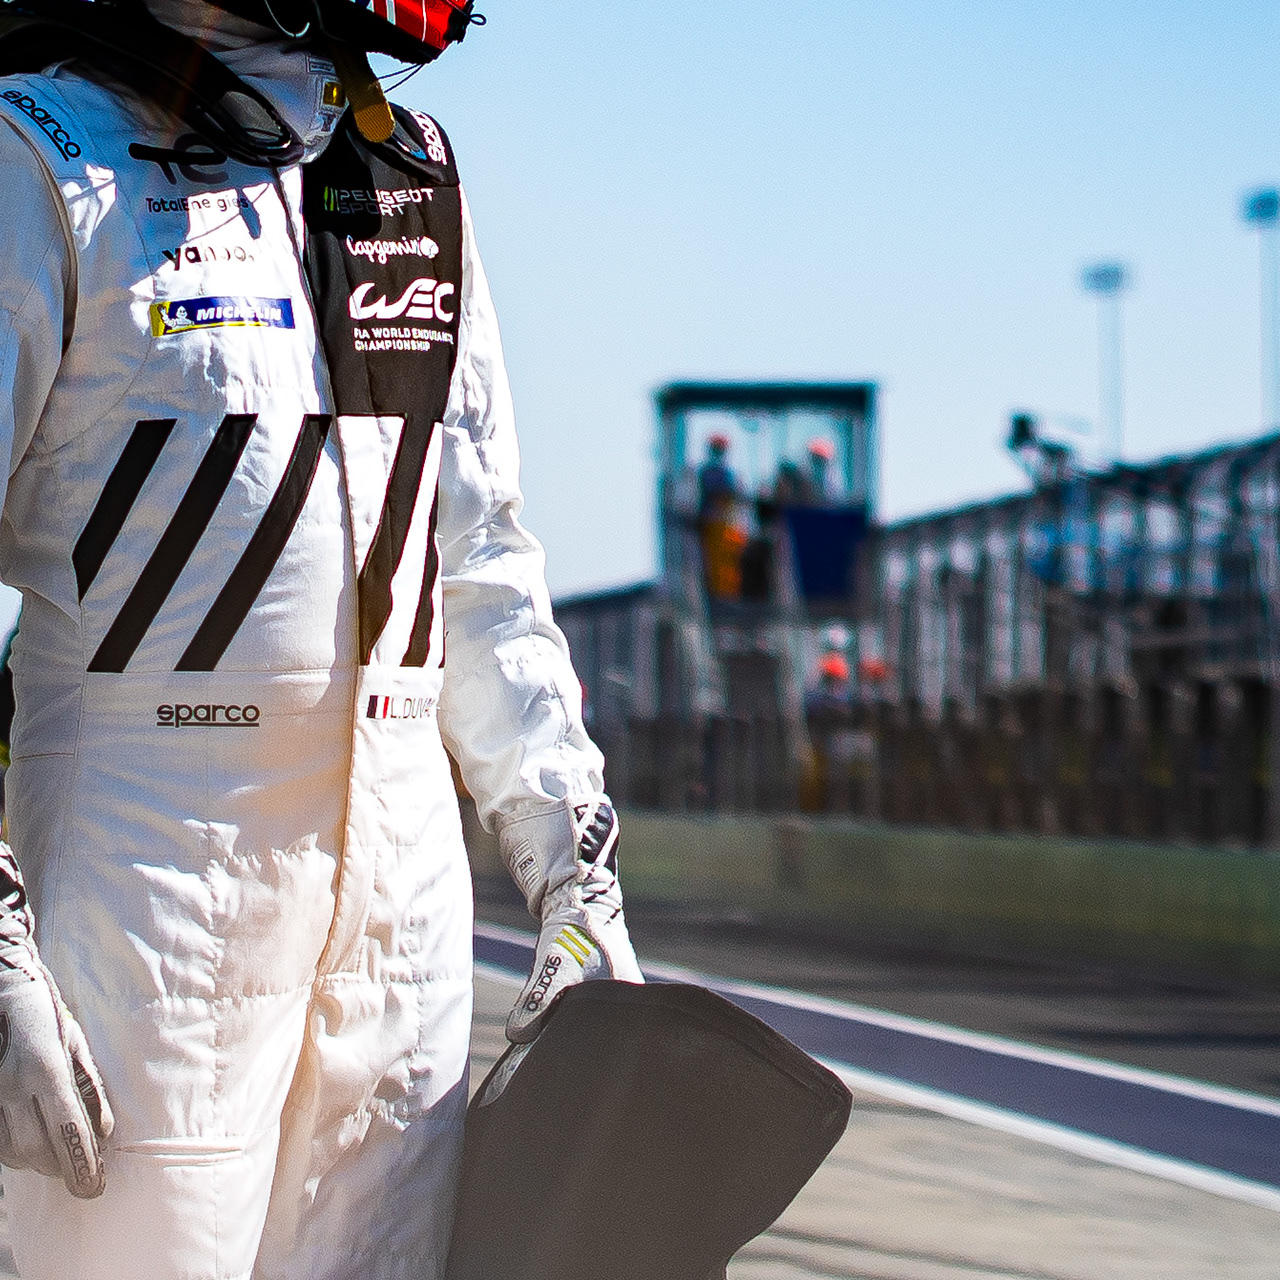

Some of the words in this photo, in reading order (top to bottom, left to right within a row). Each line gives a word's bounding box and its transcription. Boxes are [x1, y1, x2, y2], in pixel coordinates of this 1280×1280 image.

[145, 194, 249, 214] TotalEnegies
[340, 188, 434, 204] PEUGEOT
[340, 202, 405, 217] SPORT
[348, 277, 455, 323] WEC
[372, 327, 411, 340] WORLD
[354, 339, 431, 352] CHAMPIONSHIP
[155, 703, 261, 728] sparco
[522, 954, 562, 1012] sparco
